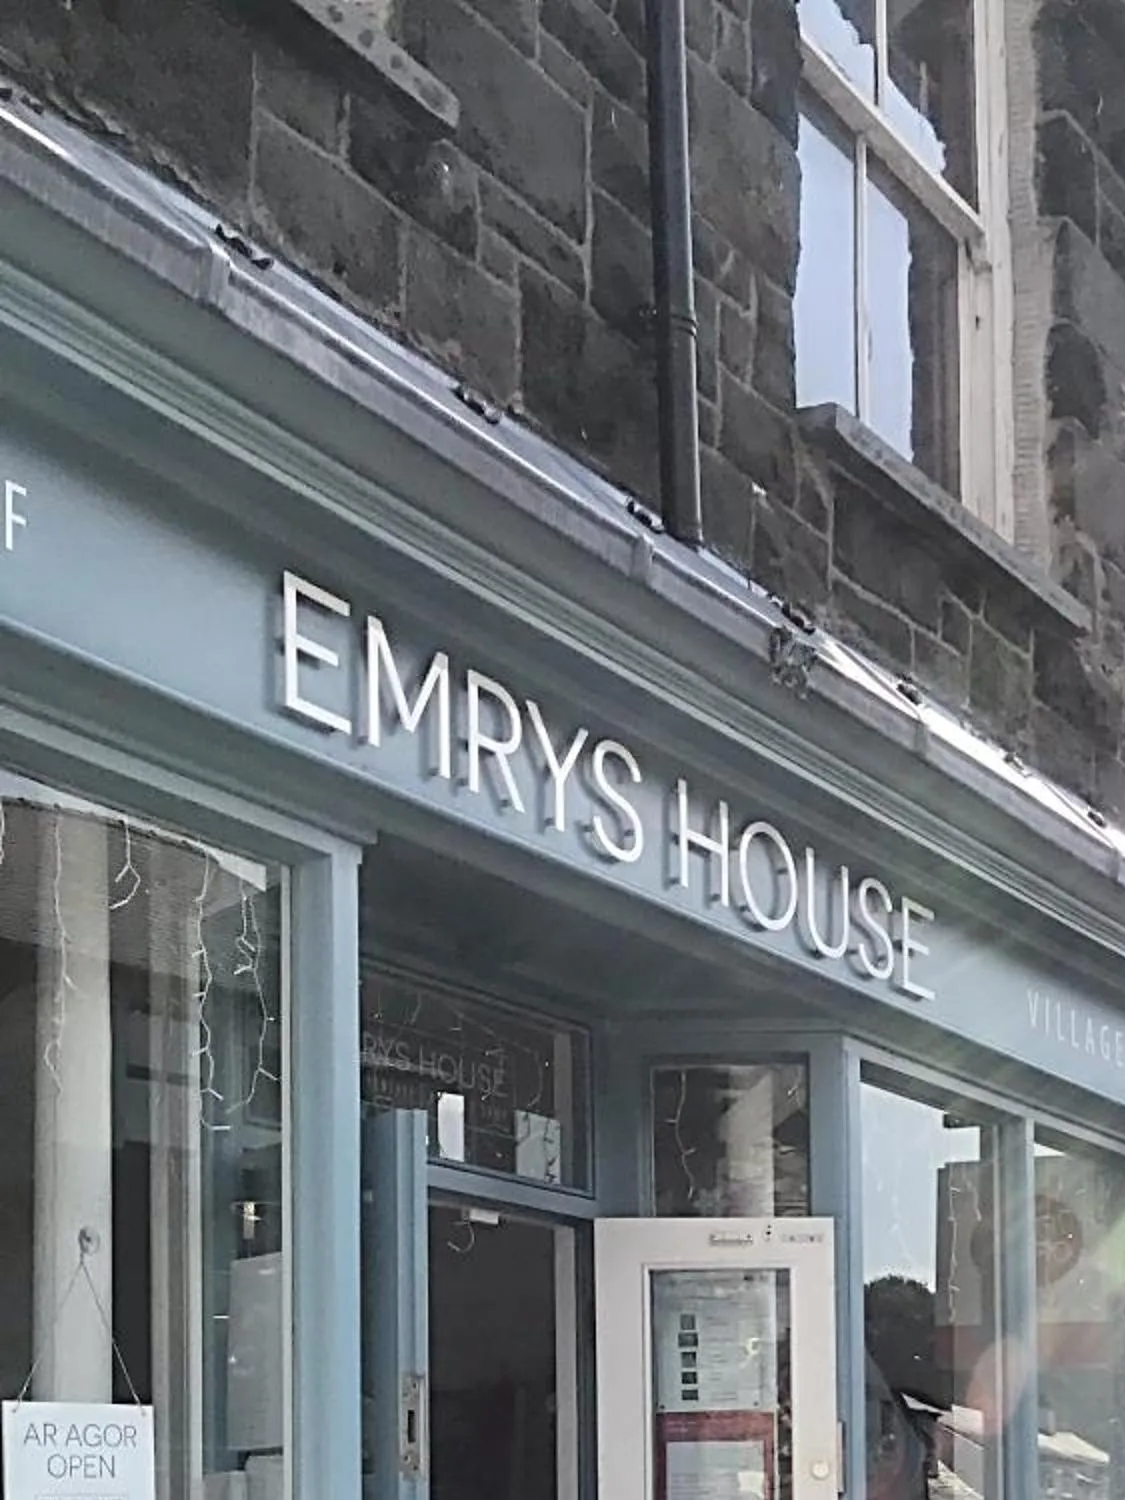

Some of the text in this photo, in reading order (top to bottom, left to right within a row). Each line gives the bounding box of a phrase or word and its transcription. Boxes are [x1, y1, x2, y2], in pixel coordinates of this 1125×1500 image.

[282, 569, 935, 1002] EMRYS HOUSE
[1027, 988, 1124, 1068] VILLAGE
[23, 1423, 137, 1448] AR AGOR
[47, 1453, 116, 1479] OPEN
